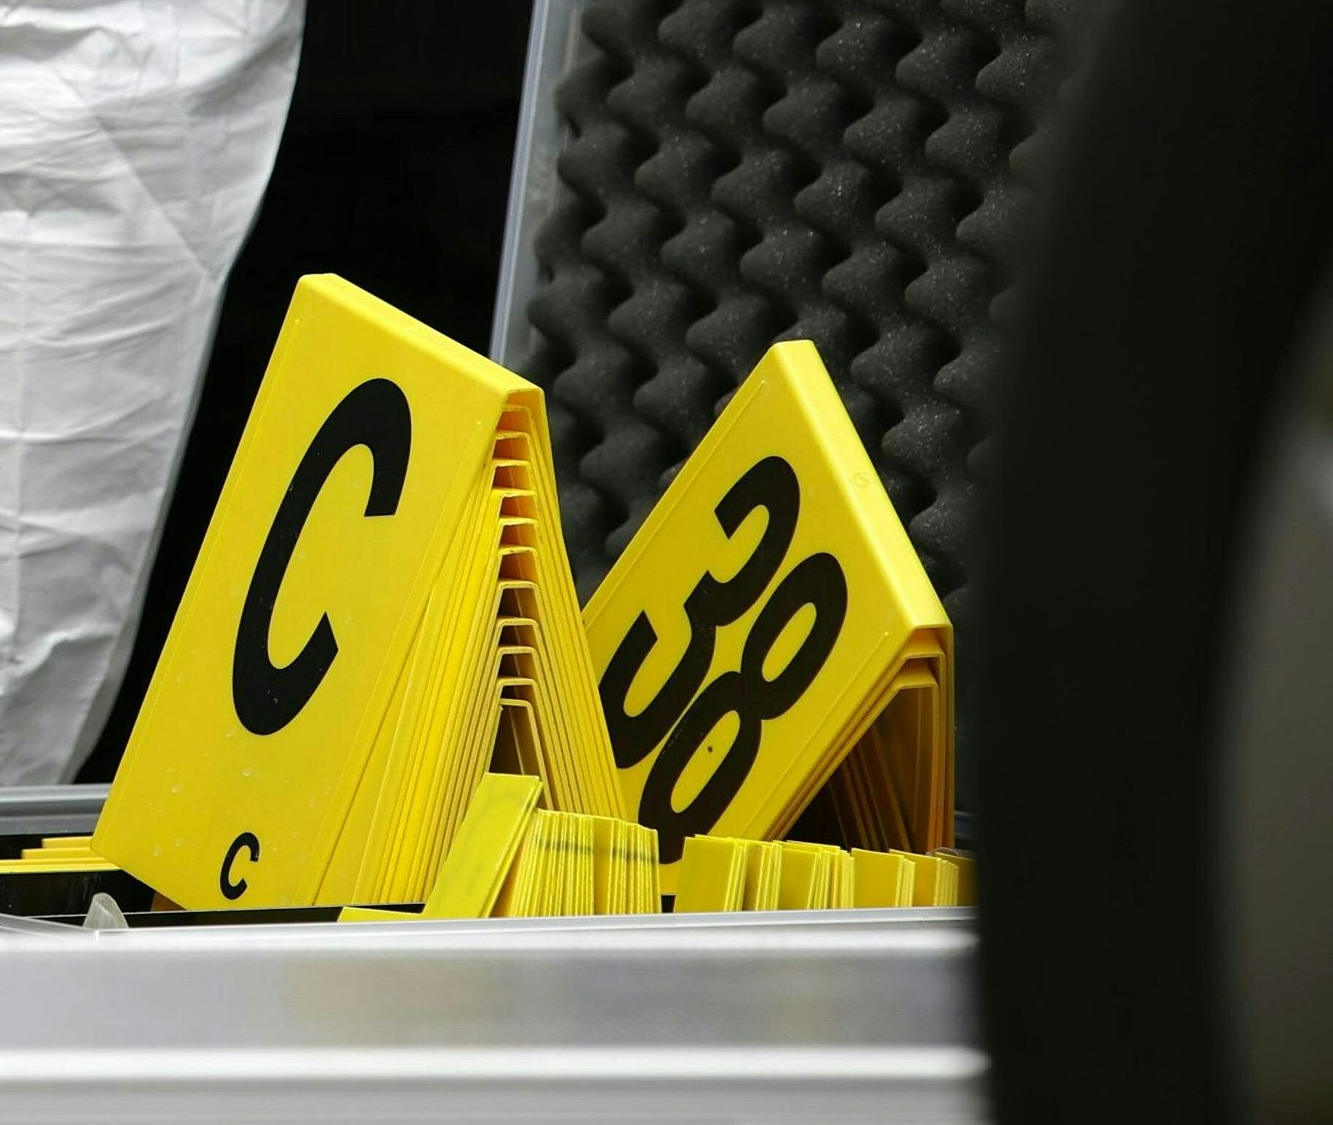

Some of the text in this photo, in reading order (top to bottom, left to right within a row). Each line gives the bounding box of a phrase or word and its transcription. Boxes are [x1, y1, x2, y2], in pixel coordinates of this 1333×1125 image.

[231, 377, 412, 736] C
[599, 455, 848, 865] 38
[219, 831, 260, 901] C
